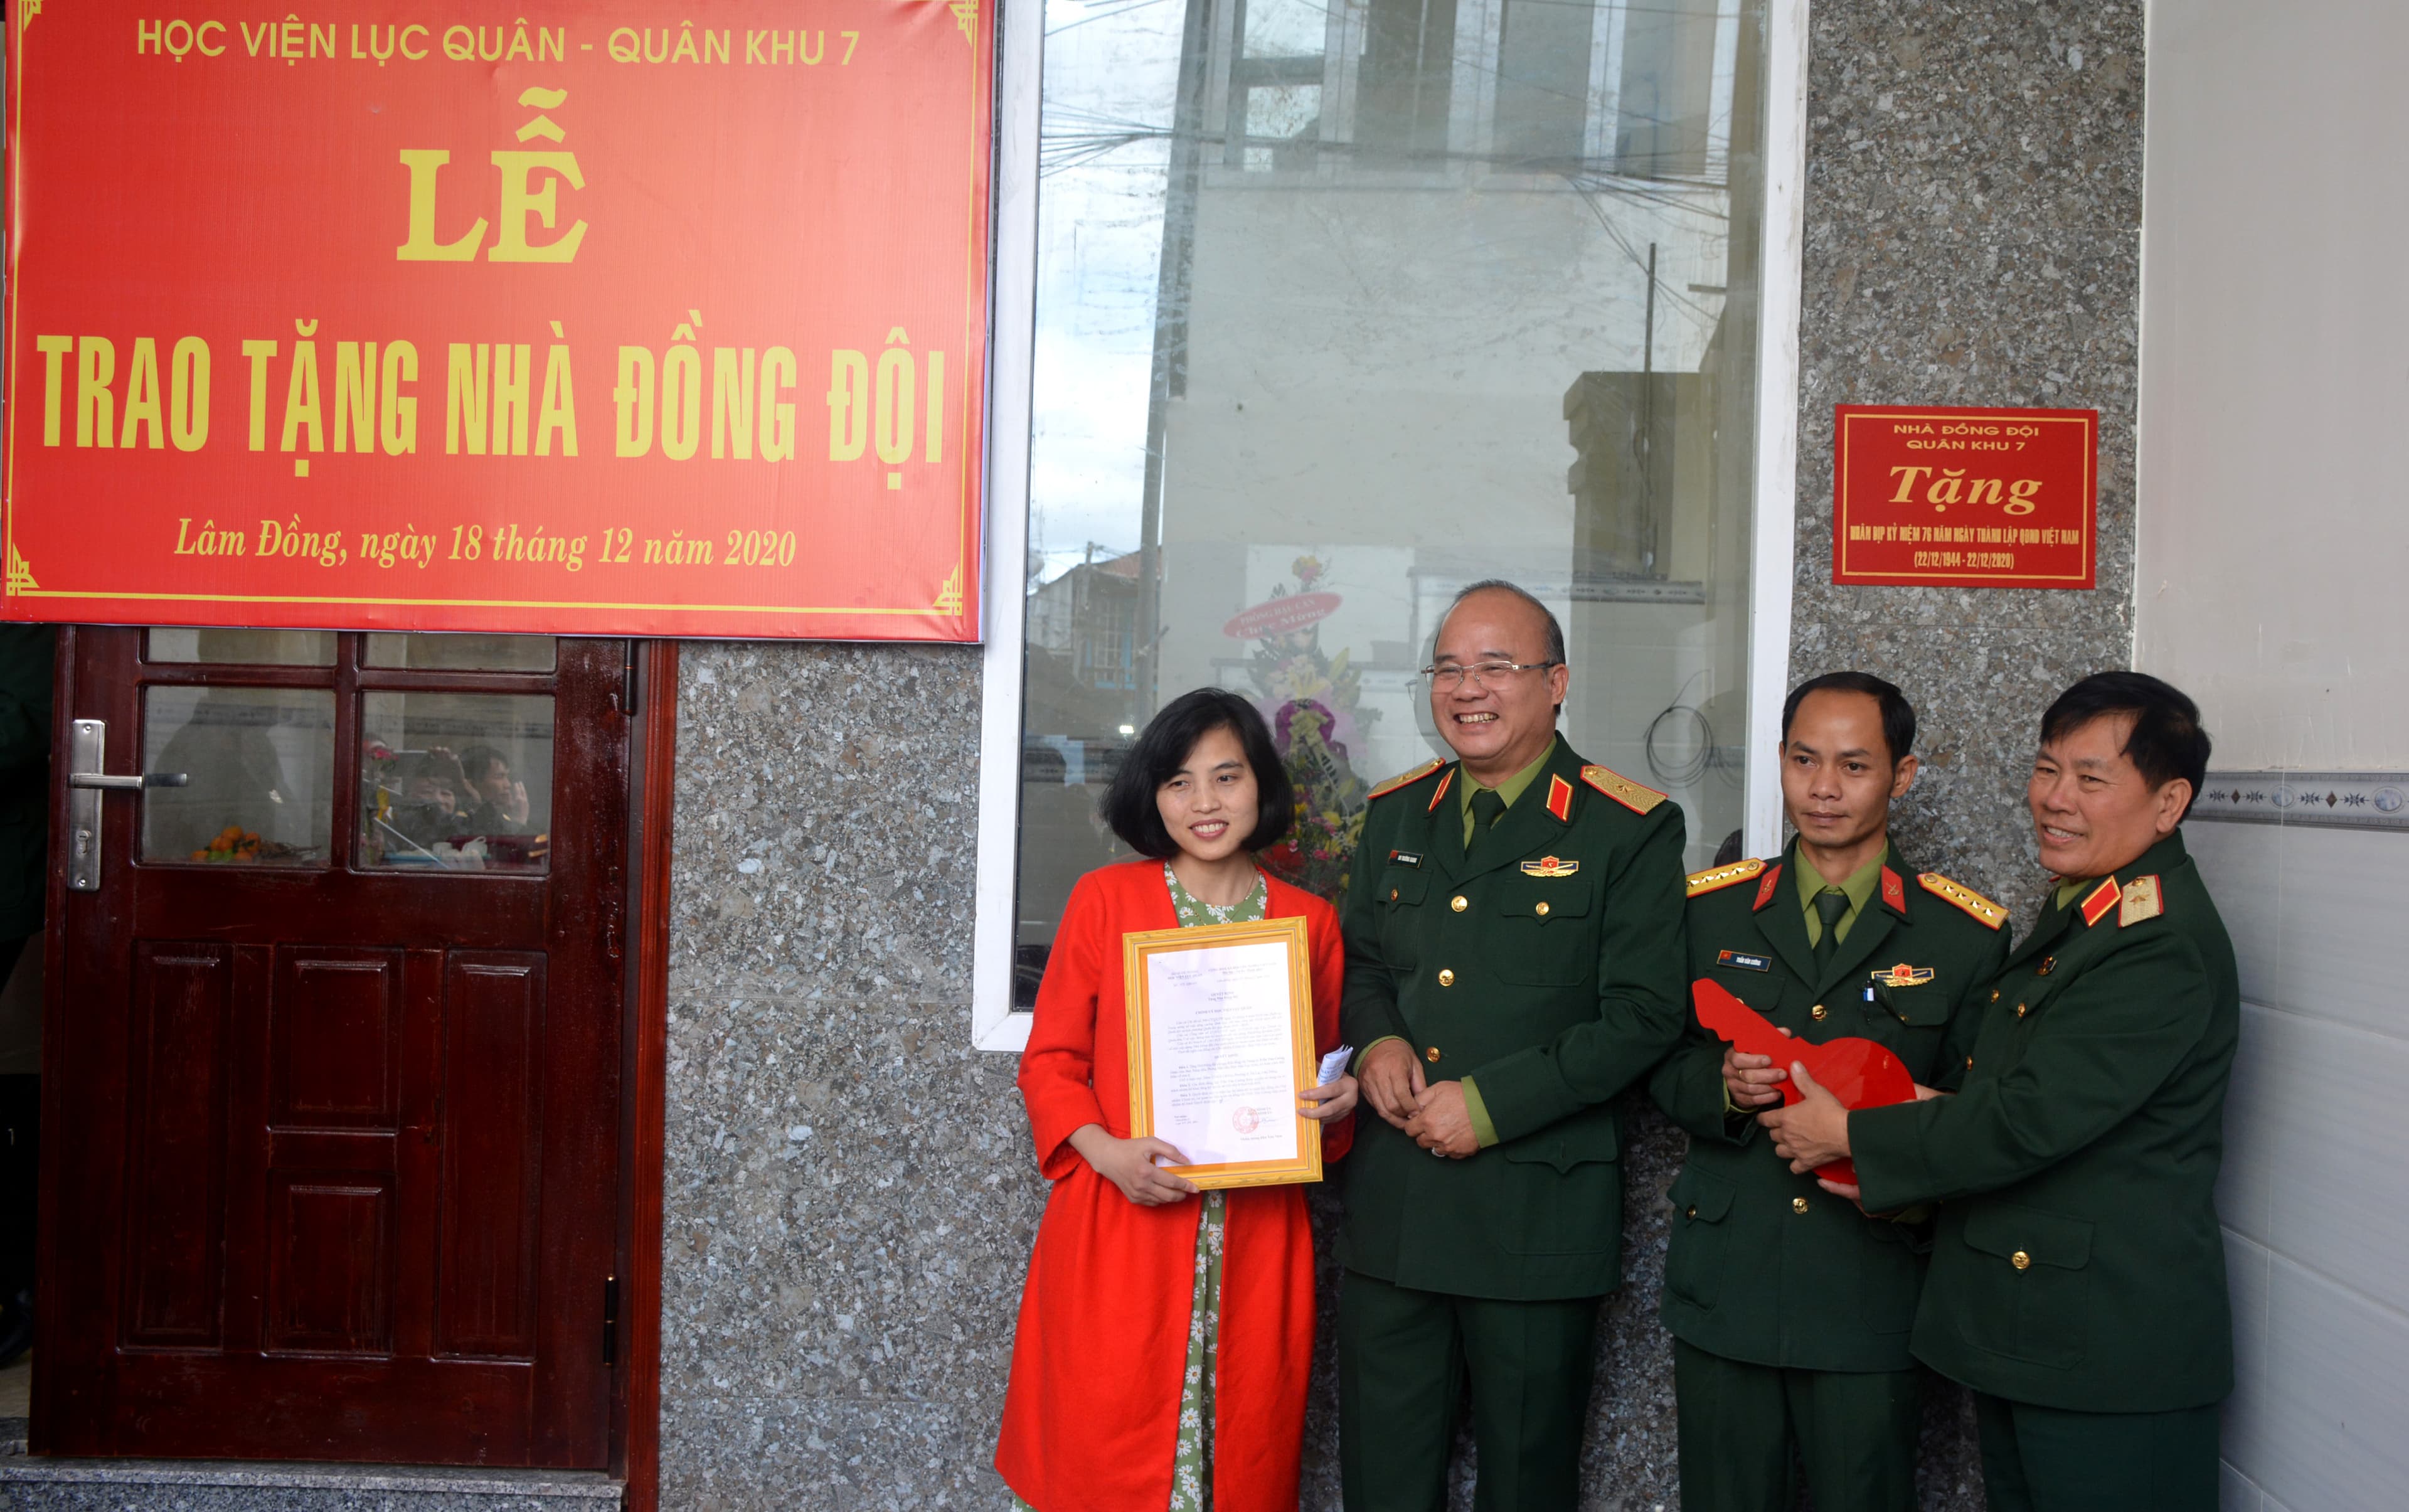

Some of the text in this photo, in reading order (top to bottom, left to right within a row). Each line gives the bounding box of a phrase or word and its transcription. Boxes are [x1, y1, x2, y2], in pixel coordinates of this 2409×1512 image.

[137, 19, 228, 63] HỌC
[241, 14, 336, 66] VIỆN
[351, 24, 430, 67] LỤC
[443, 17, 565, 61] QUÂN
[609, 20, 730, 63] QUÂN
[747, 30, 824, 65] KHU
[842, 31, 859, 65] 7
[396, 87, 588, 263] LỄ
[37, 309, 944, 489] TRAO TẶNG NHÀ ĐỒNG ĐỘI
[1895, 423, 2038, 437] NHÀ ĐỒNG ĐỘI
[1907, 439, 2024, 450] QUÂN KHU 7
[1889, 467, 2042, 514] Tặng
[174, 513, 796, 572] Lâm Đồng, ngày 18 tháng 12 năm 2020
[1954, 524, 1975, 543] NGÀY
[2041, 526, 2060, 547] VIỆT
[2061, 529, 2079, 545] NAM
